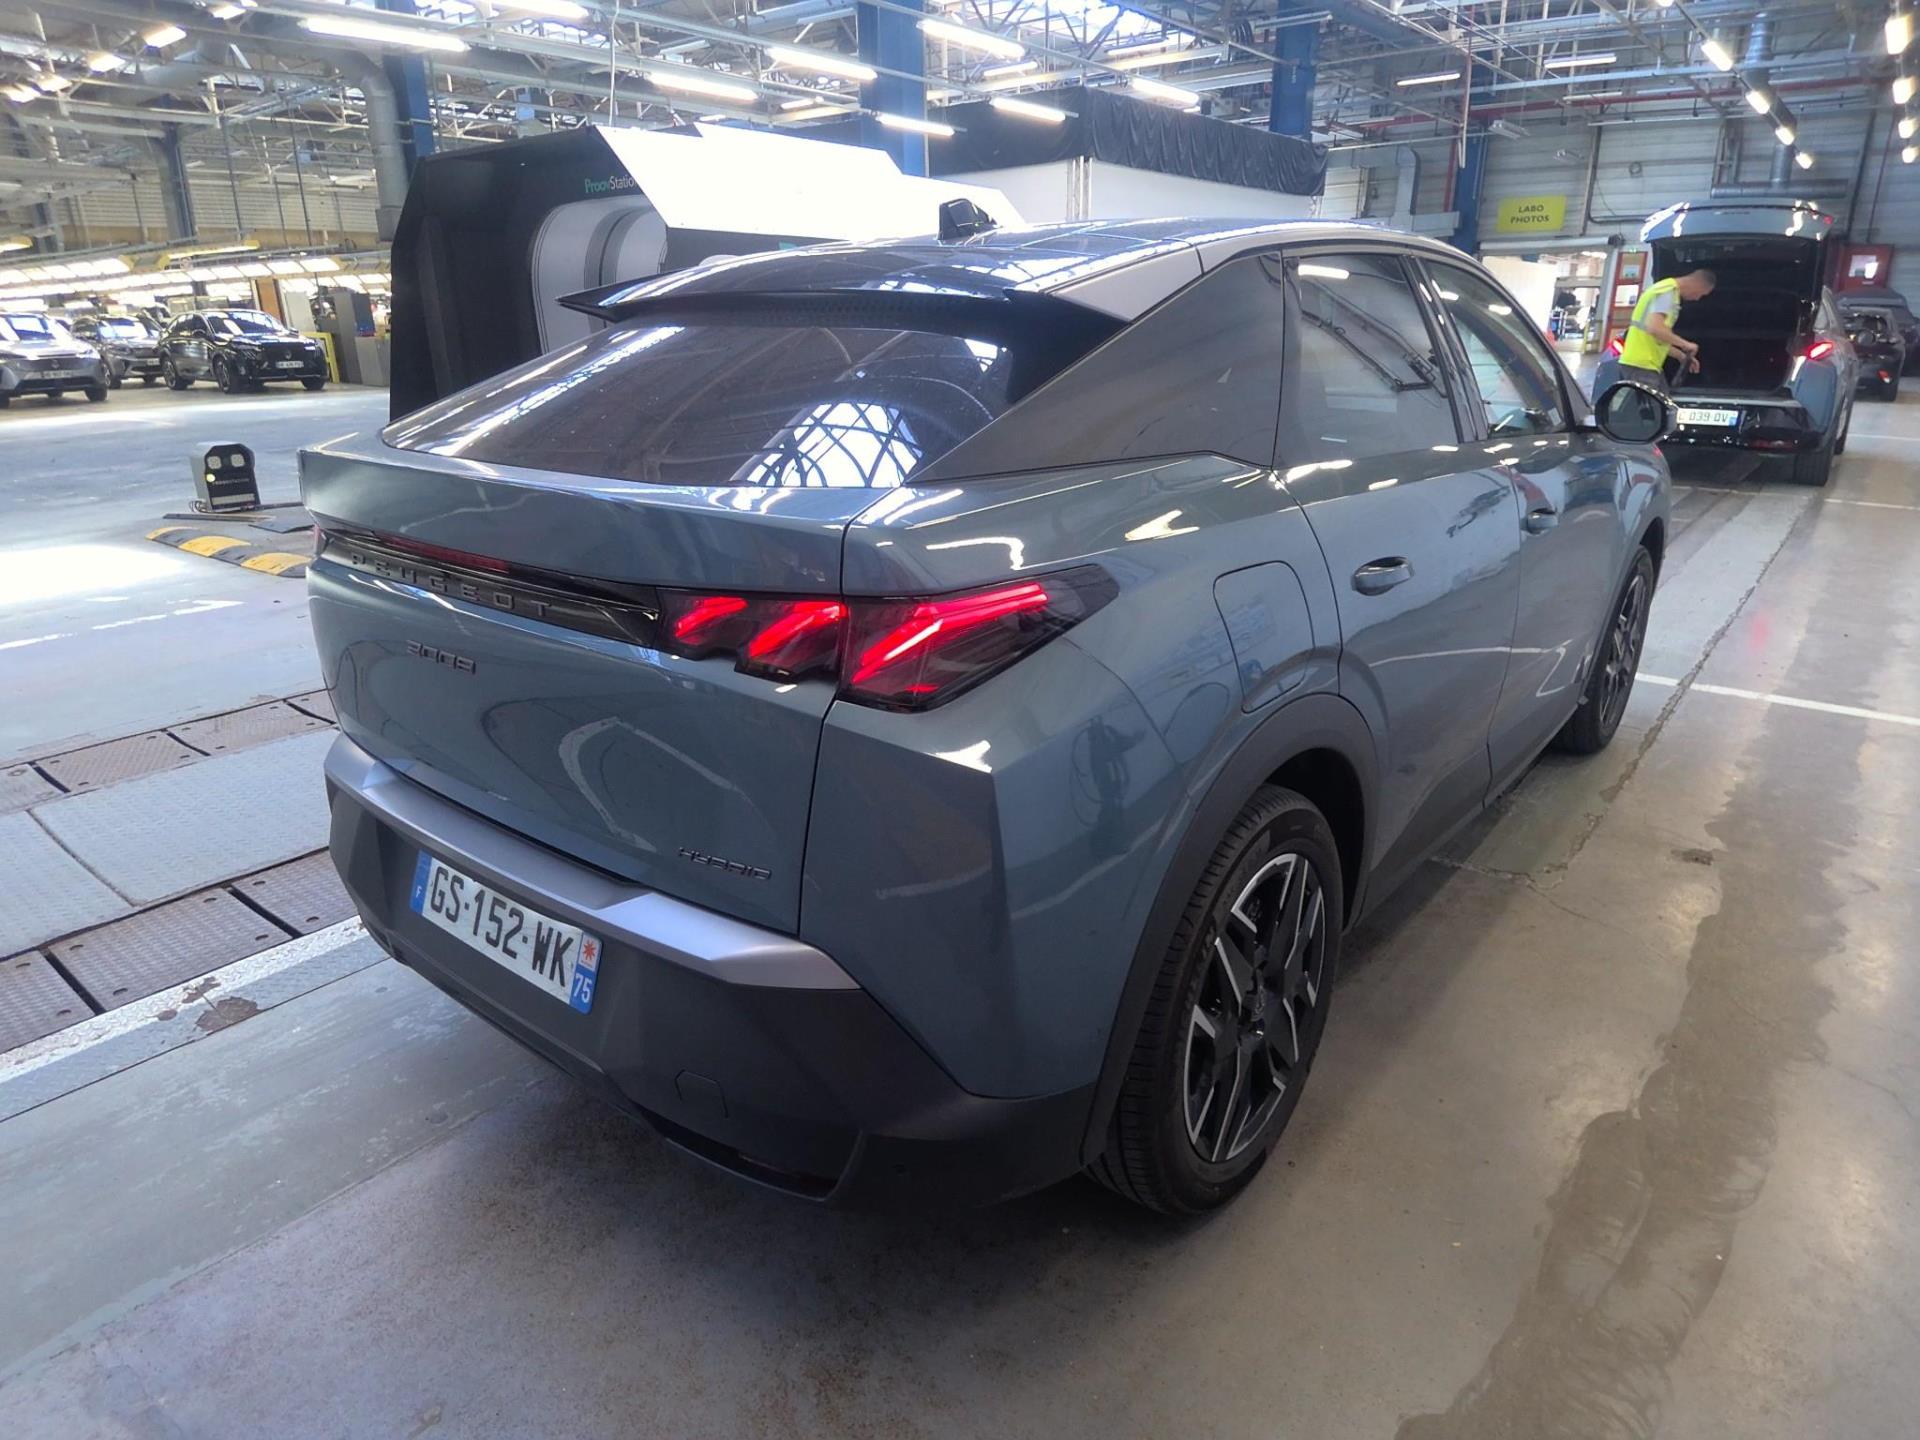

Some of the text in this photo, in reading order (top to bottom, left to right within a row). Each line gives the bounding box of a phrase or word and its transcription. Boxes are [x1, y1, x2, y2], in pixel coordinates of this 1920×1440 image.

[1510, 214, 1550, 224] PHOTOS
[1518, 204, 1545, 213] LABO
[351, 553, 552, 617] PEUGEOT
[407, 640, 476, 675] 3008
[679, 847, 772, 880] HYBRID
[415, 886, 423, 898] F
[573, 973, 593, 1003] 75
